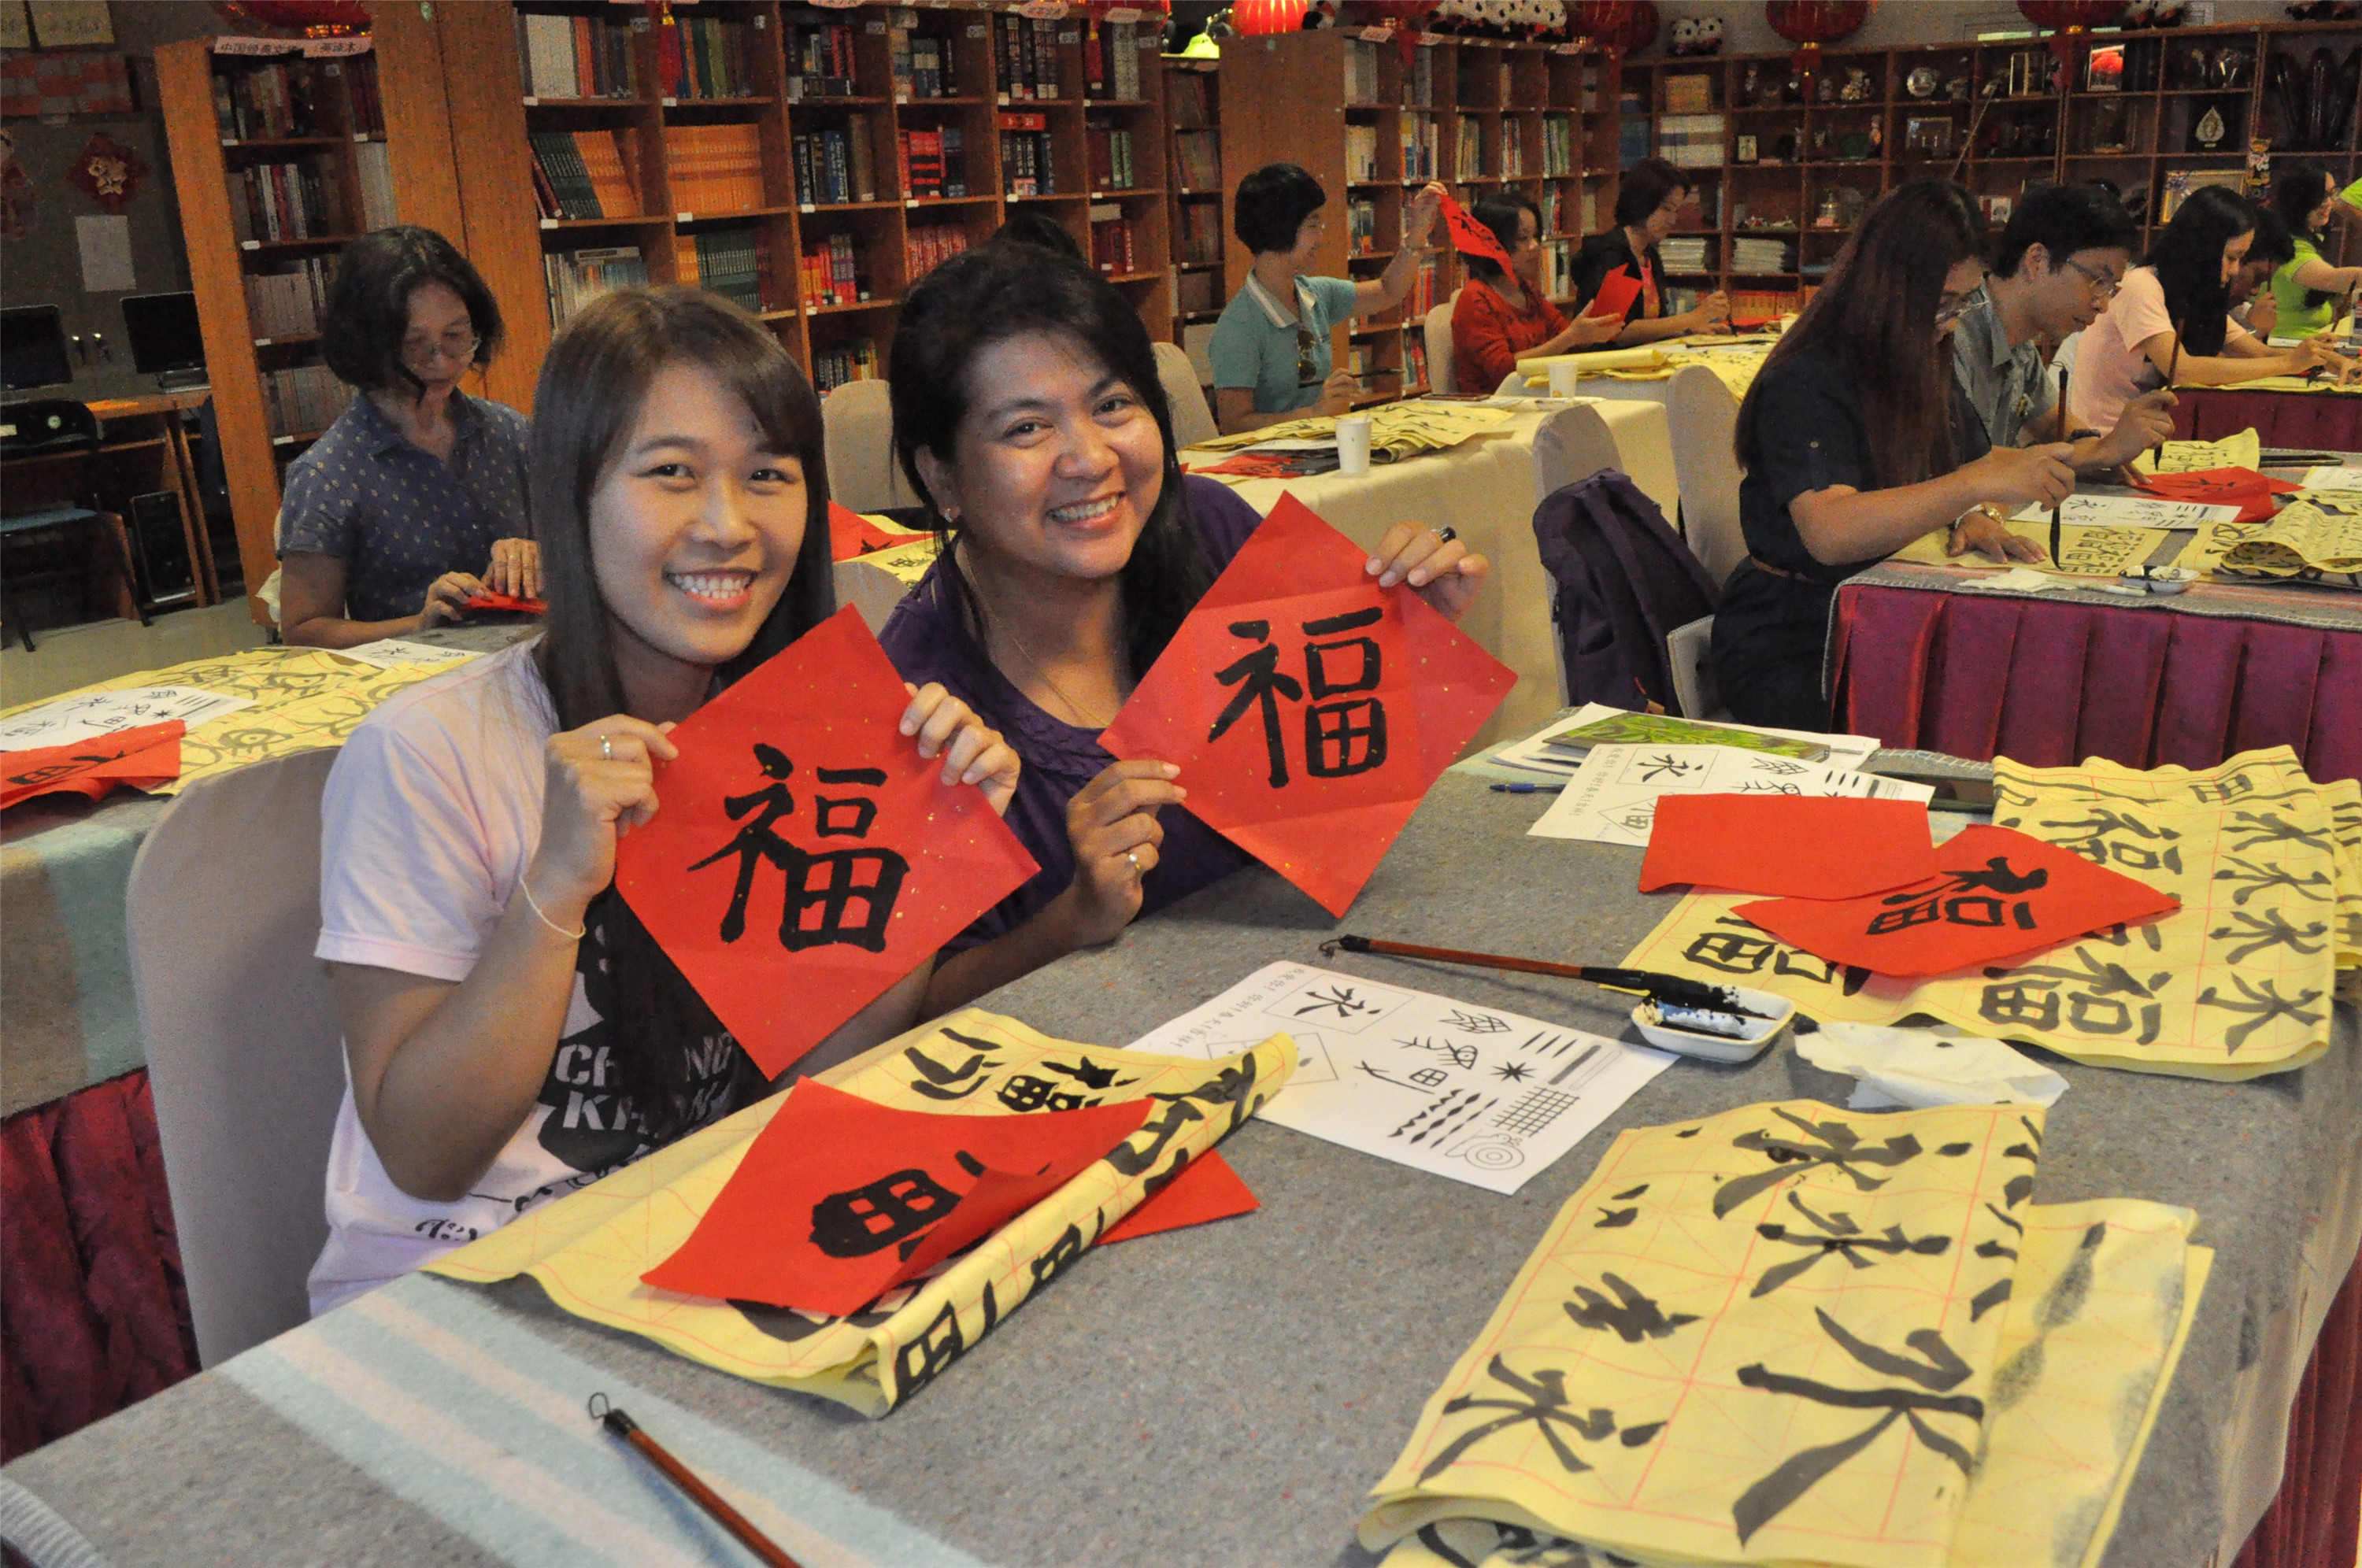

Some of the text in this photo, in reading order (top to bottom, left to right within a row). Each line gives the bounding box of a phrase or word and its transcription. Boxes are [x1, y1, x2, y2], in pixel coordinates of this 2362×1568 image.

[1208, 607, 1388, 789] 福
[1637, 754, 1704, 782] 永
[687, 743, 910, 954] 福
[1865, 856, 2049, 935] 福
[1294, 985, 1383, 1017] 永
[1978, 946, 2173, 1046] 福
[1416, 1352, 1670, 1488] 永
